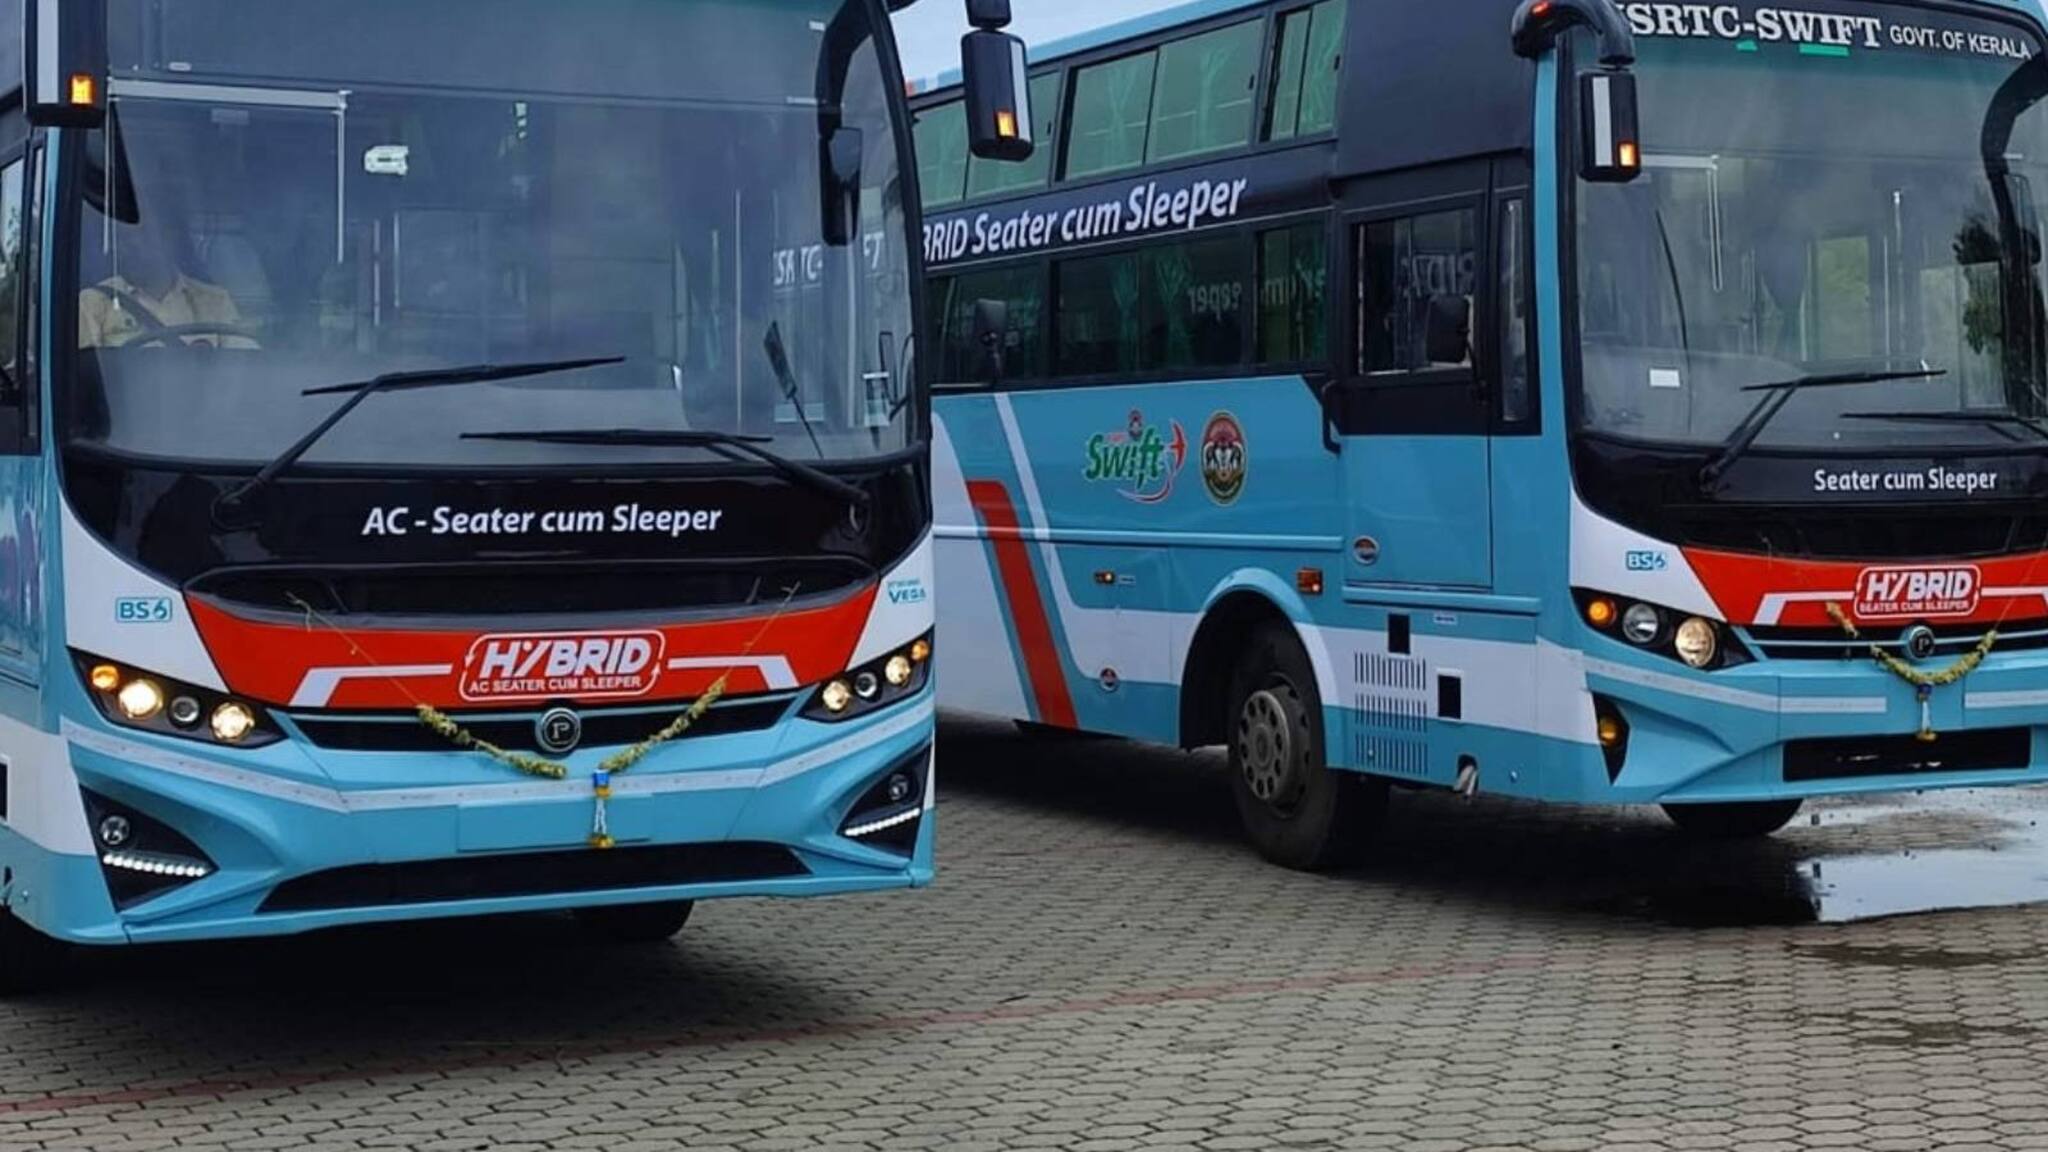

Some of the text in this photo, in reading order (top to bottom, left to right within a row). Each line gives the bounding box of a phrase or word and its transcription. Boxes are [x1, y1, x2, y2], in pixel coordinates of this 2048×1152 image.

[1616, 3, 2032, 60] SRTC-SWIFT GOVT. OF KERALA
[971, 209, 1058, 254] Seater
[1061, 199, 1121, 241] cum
[1125, 178, 1247, 231] Sleeper
[1086, 428, 1165, 489] Swift
[1814, 466, 1998, 495] Seater cum Sleeper
[361, 507, 409, 536] AC
[431, 505, 535, 534] Seater
[540, 511, 605, 533] cum
[612, 504, 722, 538] Sleeper
[1866, 570, 1972, 601] HYBRID
[1860, 600, 1969, 613] SEATER CUM SLEEPER
[479, 637, 651, 679] HYBRID
[469, 675, 642, 694] AC SEATER CUM SLEEPER
